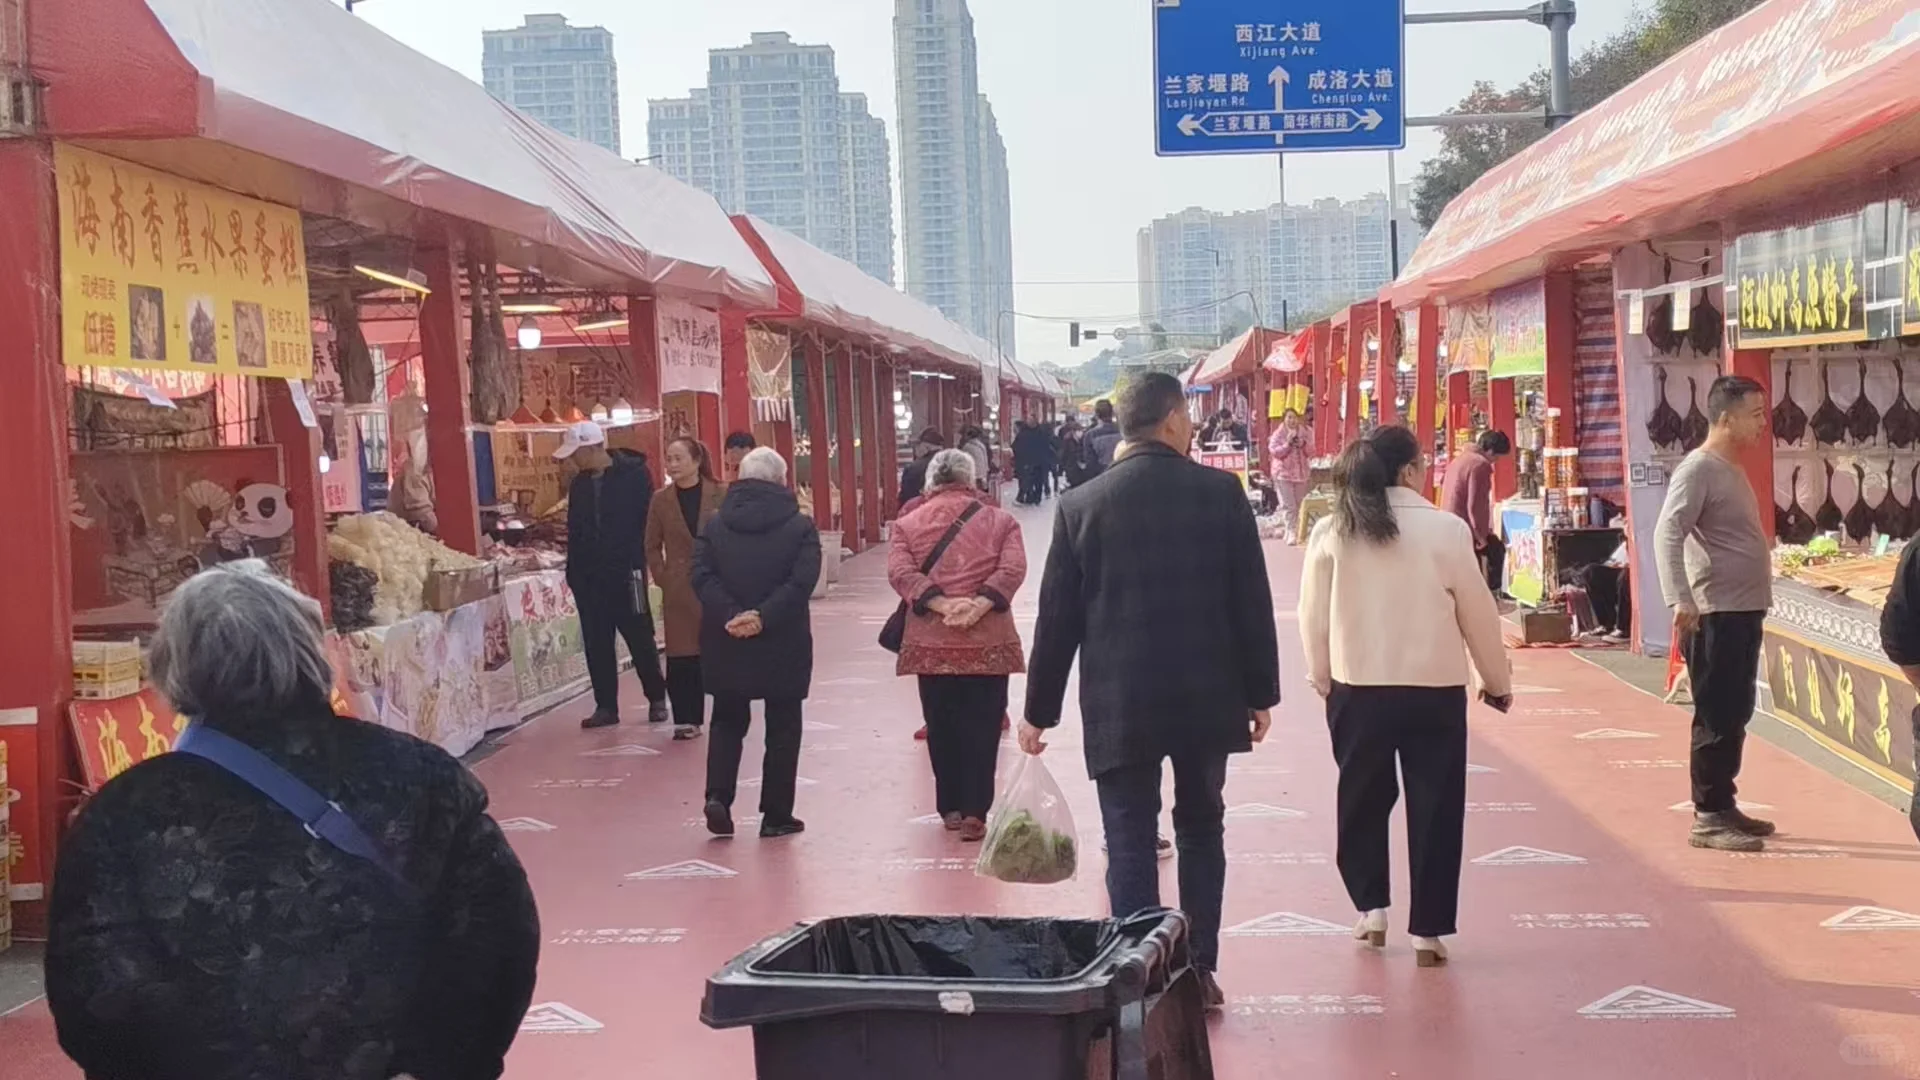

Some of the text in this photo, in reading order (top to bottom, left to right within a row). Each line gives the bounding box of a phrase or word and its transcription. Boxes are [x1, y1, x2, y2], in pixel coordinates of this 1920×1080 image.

[1235, 22, 1322, 43] 西江大道
[1240, 45, 1318, 59] Xijiang Ave.
[1164, 72, 1250, 95] 兰家堰路
[1307, 68, 1394, 90] 成洛大道
[1231, 96, 1249, 107] Rd.
[1311, 91, 1391, 106] Chengluo Ave.
[1213, 115, 1271, 132] 兰家堰路
[1283, 112, 1349, 131] 简华桥南路
[69, 160, 303, 288] 海南香蕉水果蛋糕
[83, 310, 116, 358] 低糖
